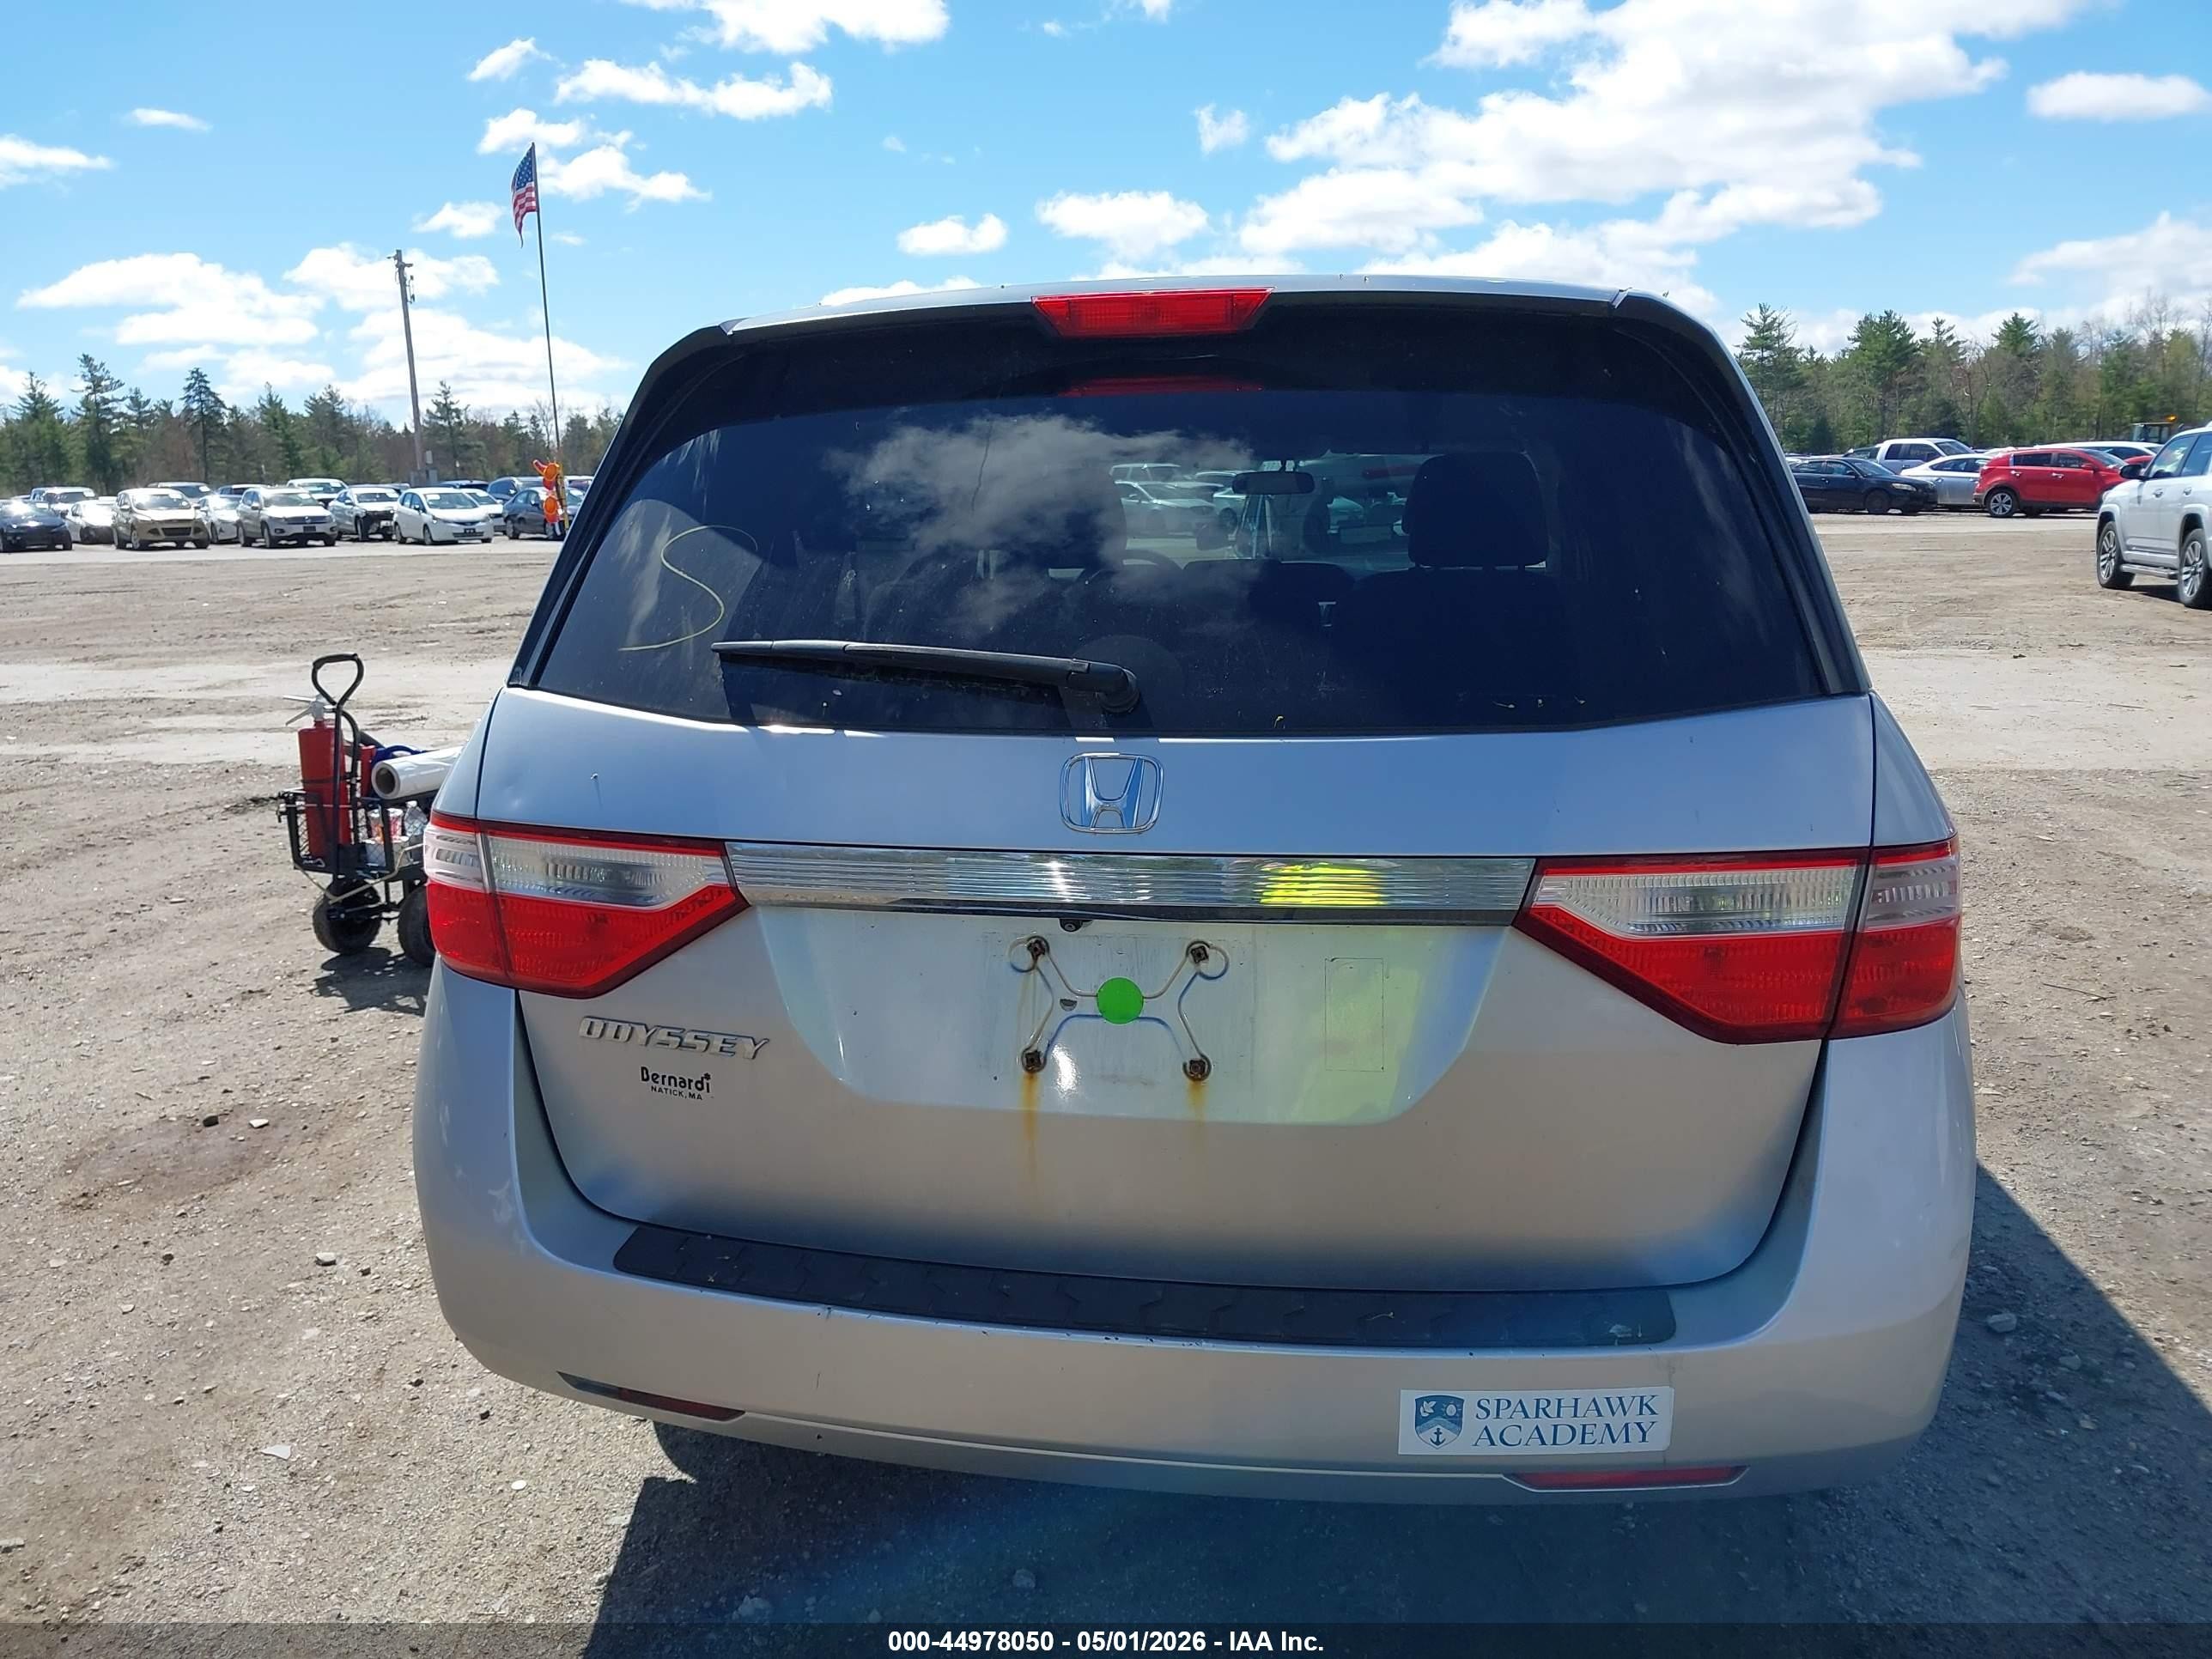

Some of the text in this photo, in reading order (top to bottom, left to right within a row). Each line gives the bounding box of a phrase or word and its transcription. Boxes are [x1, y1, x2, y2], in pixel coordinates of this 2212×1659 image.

[579, 1015, 769, 1060] ODYSSEY
[641, 1066, 711, 1093] Bernardi
[1475, 1395, 1659, 1419] SPARHAWK
[1472, 1421, 1658, 1447] ACADEMY
